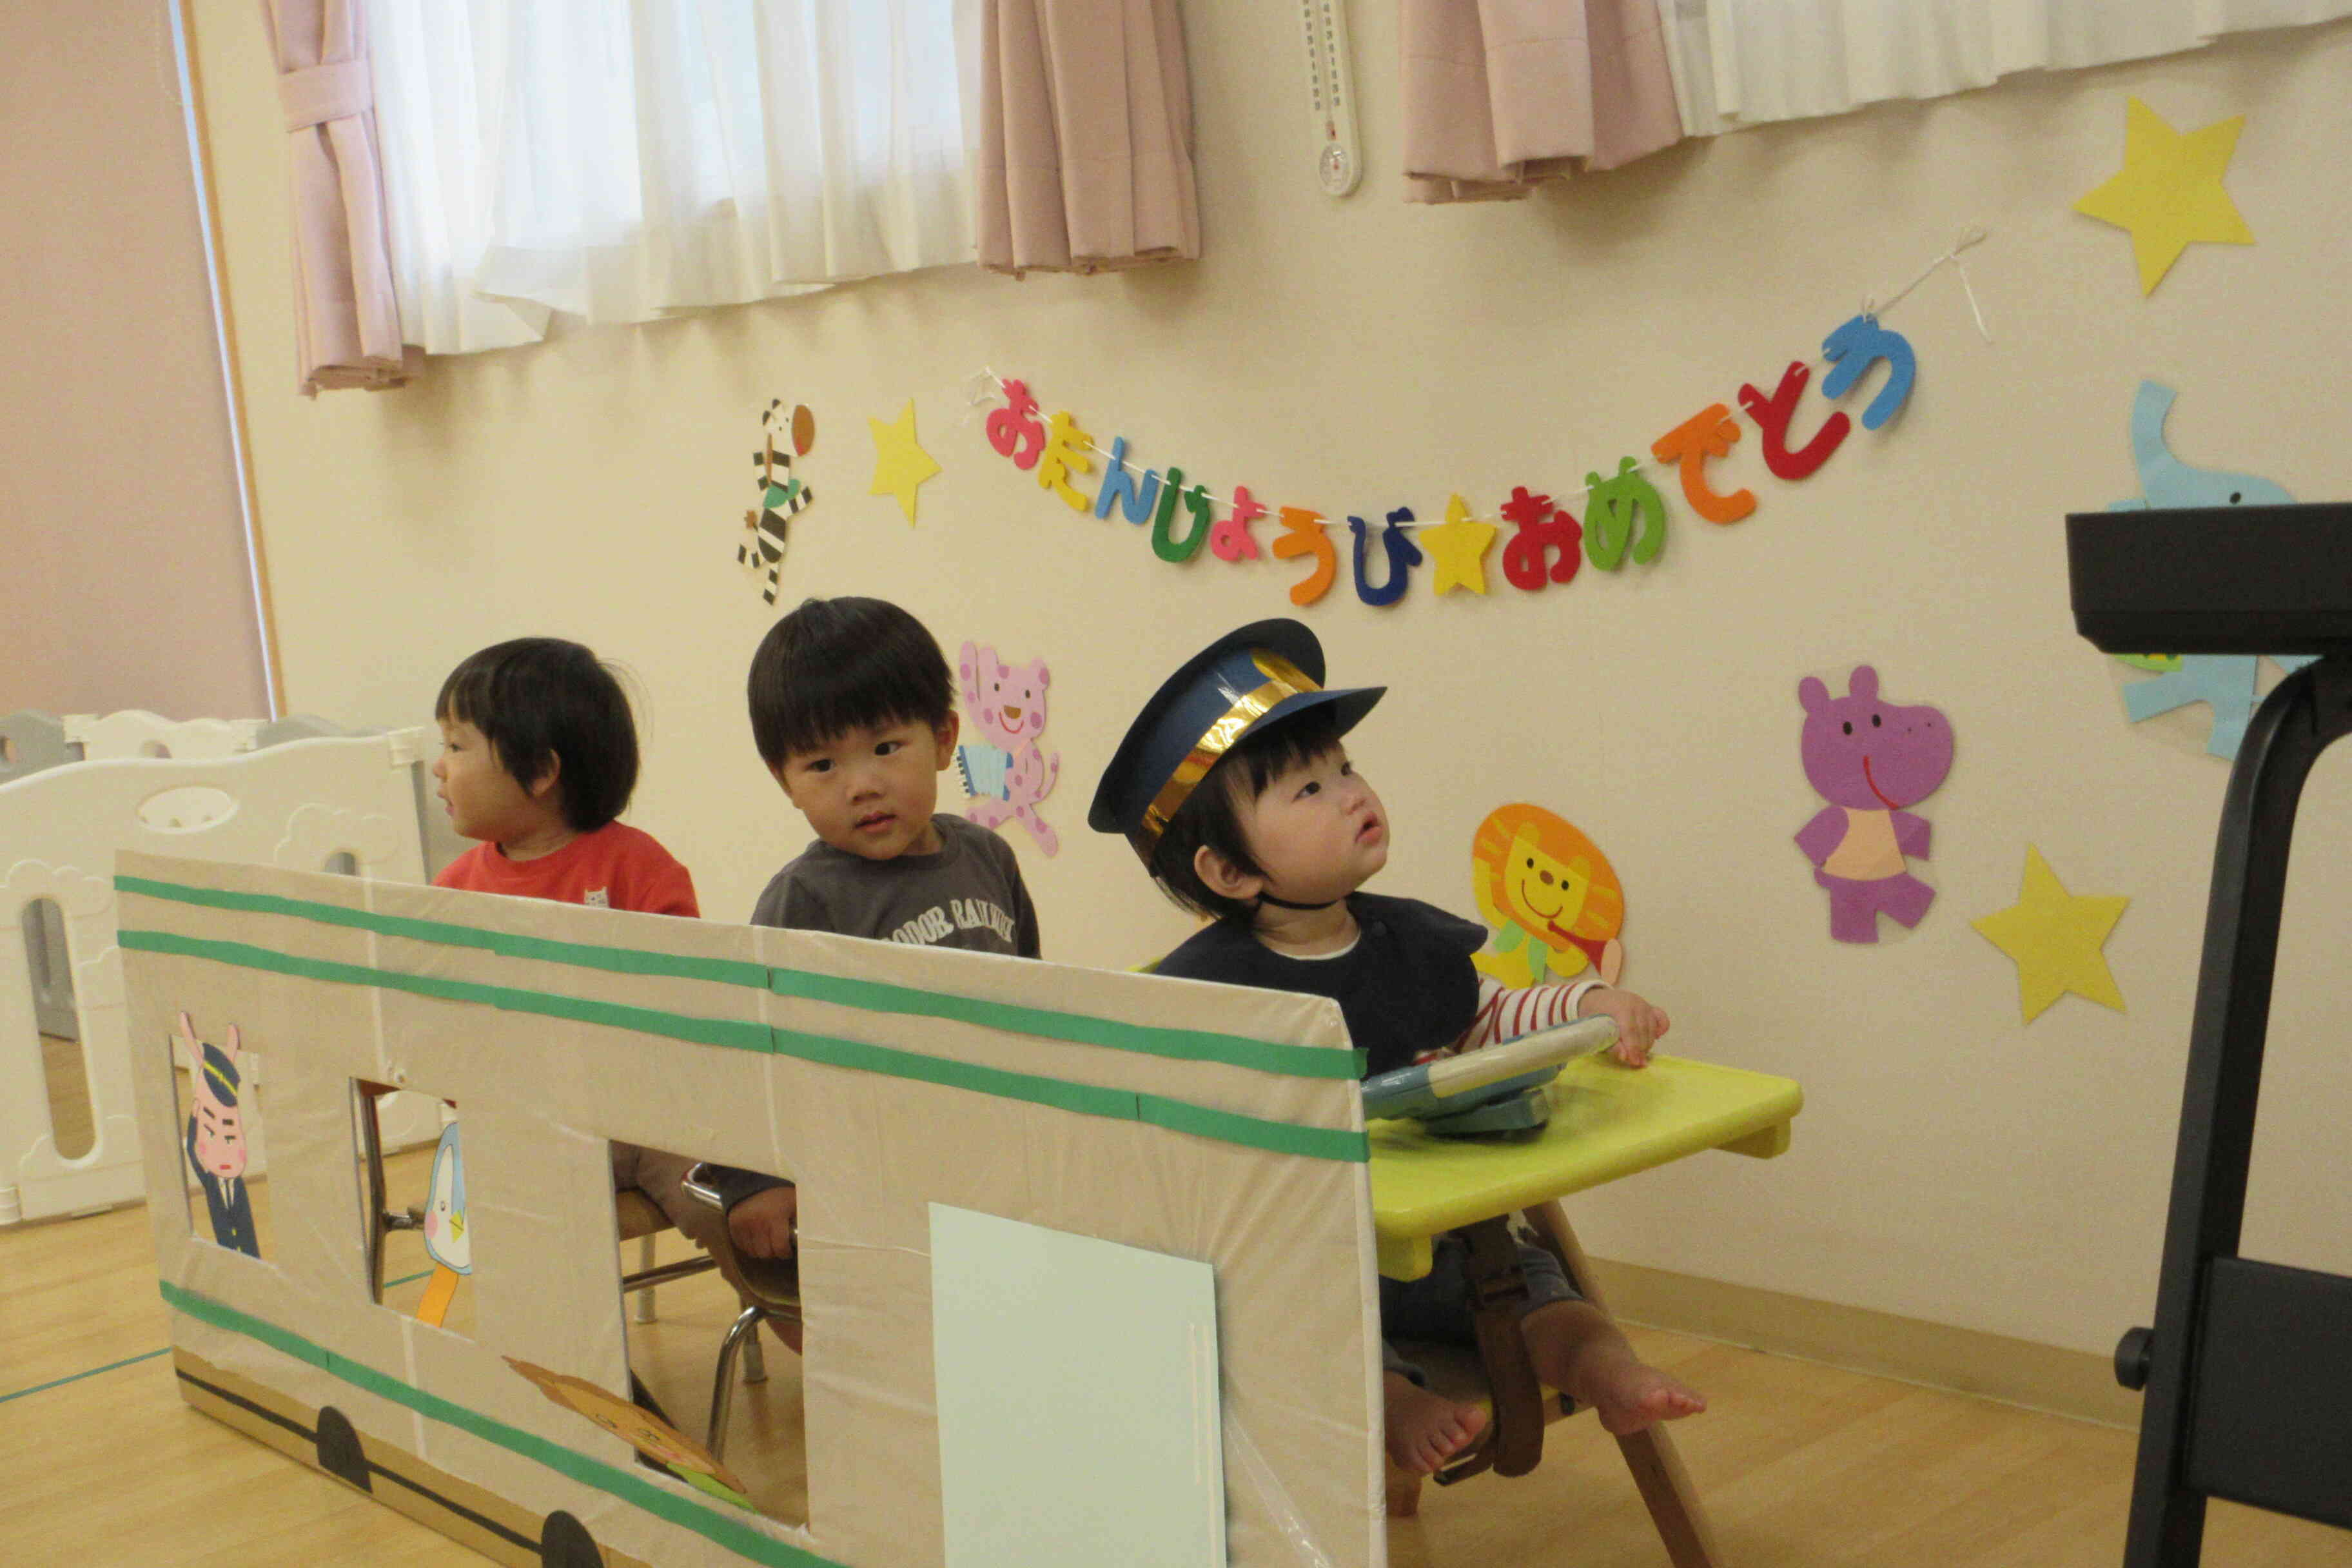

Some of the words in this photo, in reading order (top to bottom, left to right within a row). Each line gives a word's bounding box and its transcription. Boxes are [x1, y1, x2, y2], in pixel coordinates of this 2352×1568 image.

[986, 379, 1422, 606] おたんじょうび
[1500, 313, 1916, 591] おめでとう
